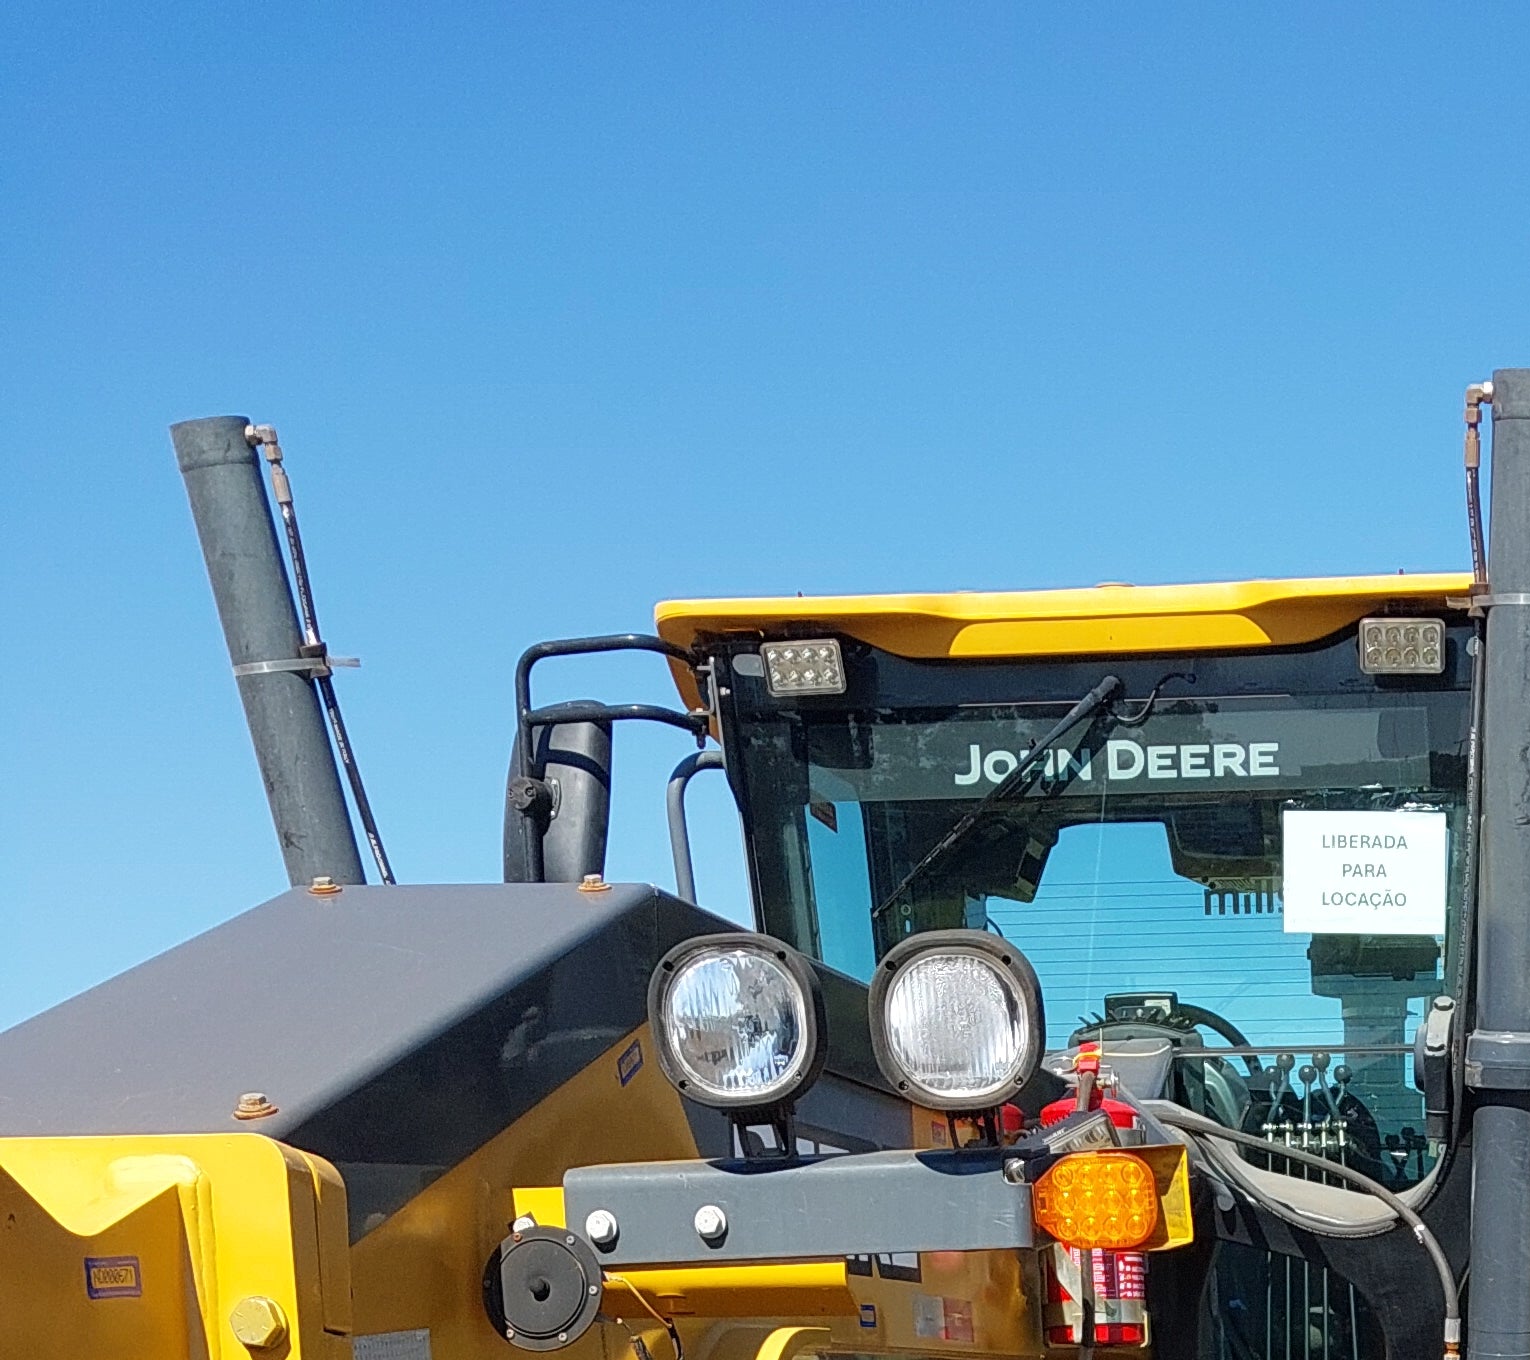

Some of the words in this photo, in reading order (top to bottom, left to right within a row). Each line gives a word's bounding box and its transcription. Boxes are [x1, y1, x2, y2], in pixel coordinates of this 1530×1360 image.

[1107, 739, 1280, 780] DEERE
[1321, 834, 1409, 850] LIBERADA
[1342, 863, 1388, 878] PARA
[1203, 877, 1284, 916] mill
[1321, 888, 1408, 911] LOCAÇÃO
